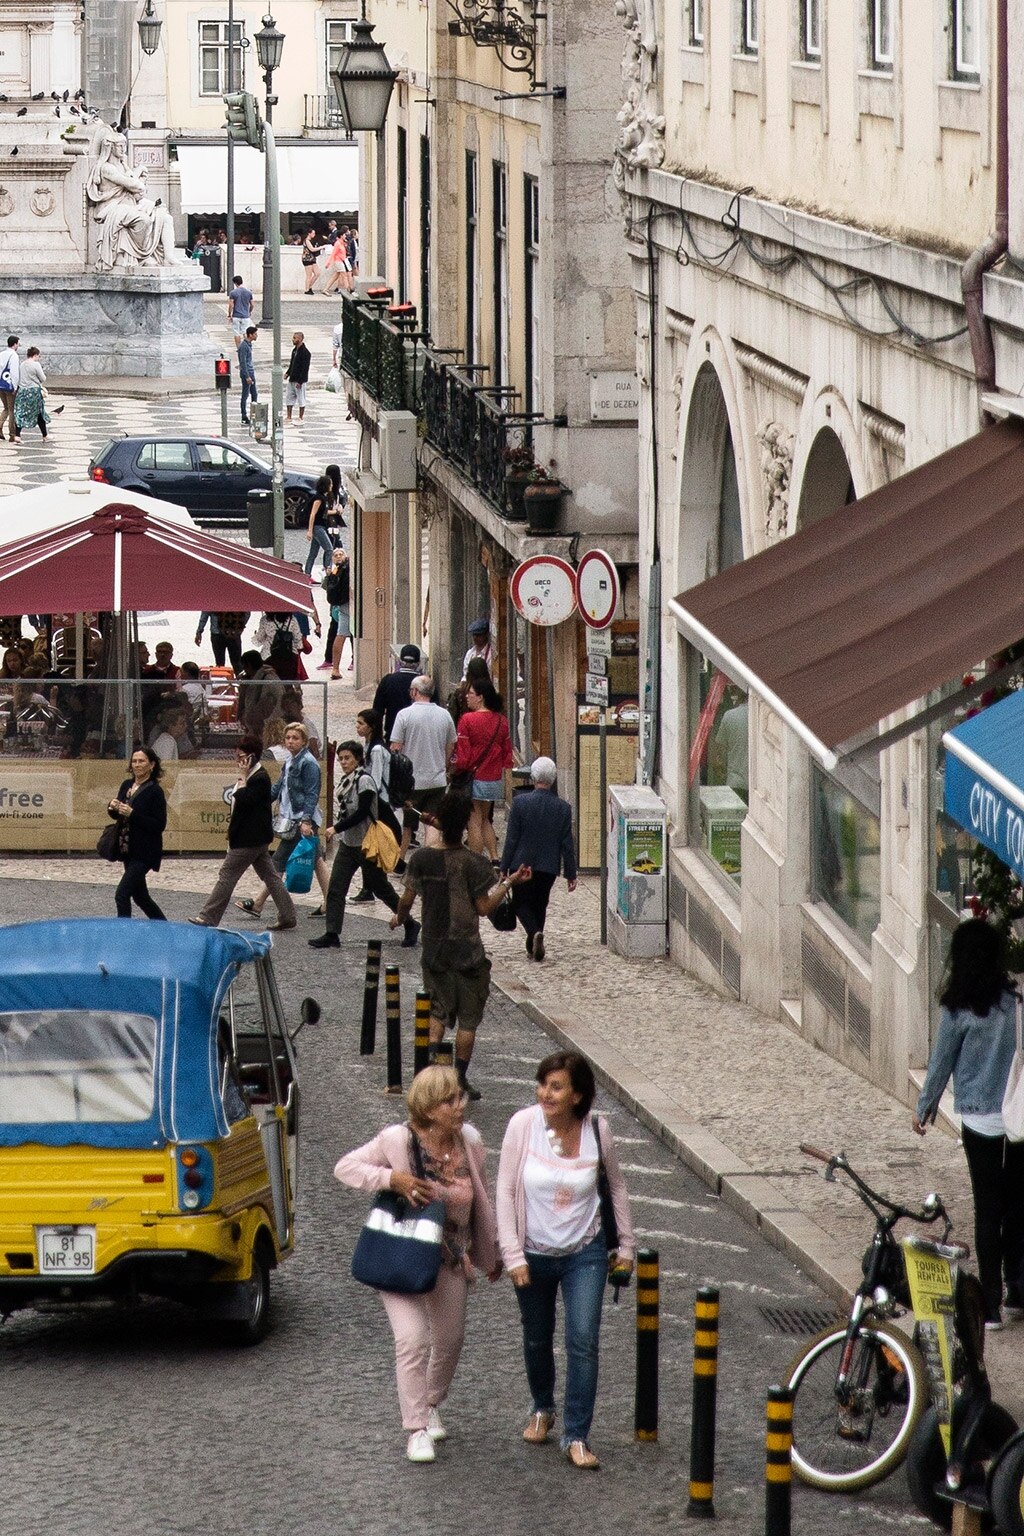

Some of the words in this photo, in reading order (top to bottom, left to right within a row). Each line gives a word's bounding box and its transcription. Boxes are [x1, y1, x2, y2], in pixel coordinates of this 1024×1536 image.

[615, 382, 632, 391] RUA
[600, 400, 611, 409] DE
[613, 400, 639, 409] DEZEM
[21, 811, 45, 819] zone
[969, 782, 1002, 844] CITY
[61, 1237, 75, 1251] 81
[917, 1272, 950, 1285] RENTALS
